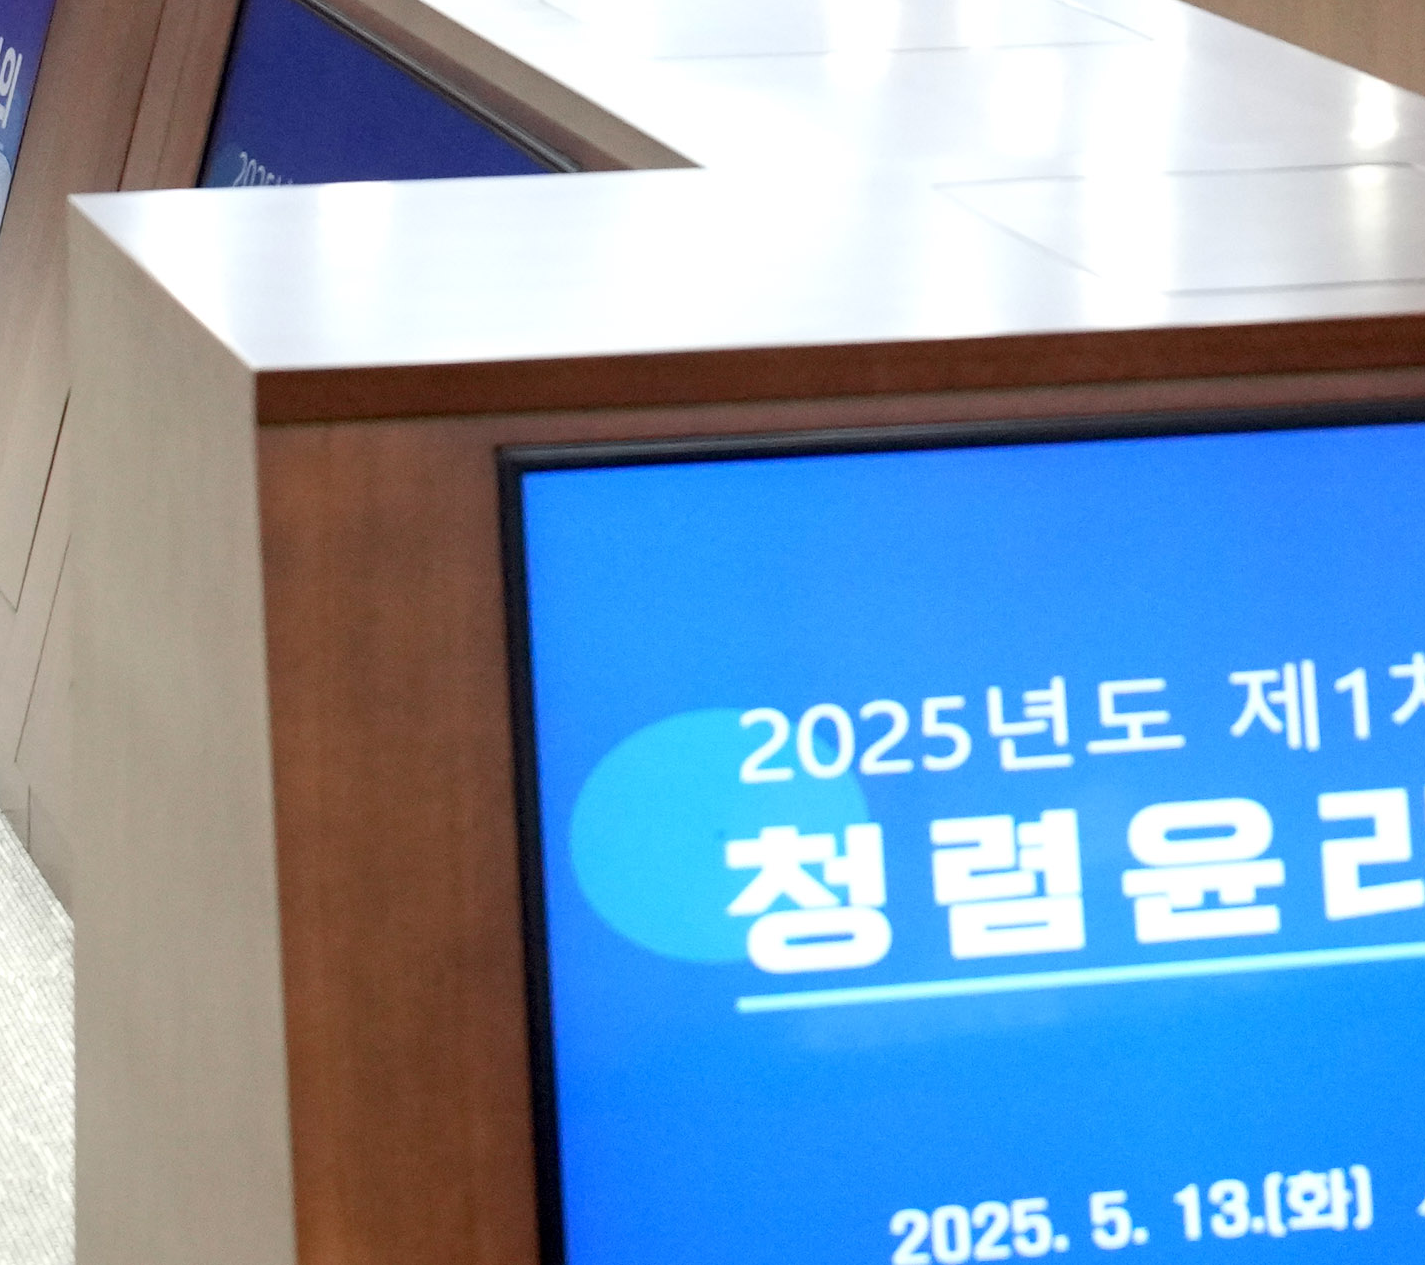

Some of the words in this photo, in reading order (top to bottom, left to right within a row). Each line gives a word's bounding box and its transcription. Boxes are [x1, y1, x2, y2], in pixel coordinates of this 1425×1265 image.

[736, 674, 1187, 784] 2025년도
[890, 1191, 1071, 1265] 2025.
[1090, 1187, 1149, 1250] 5.
